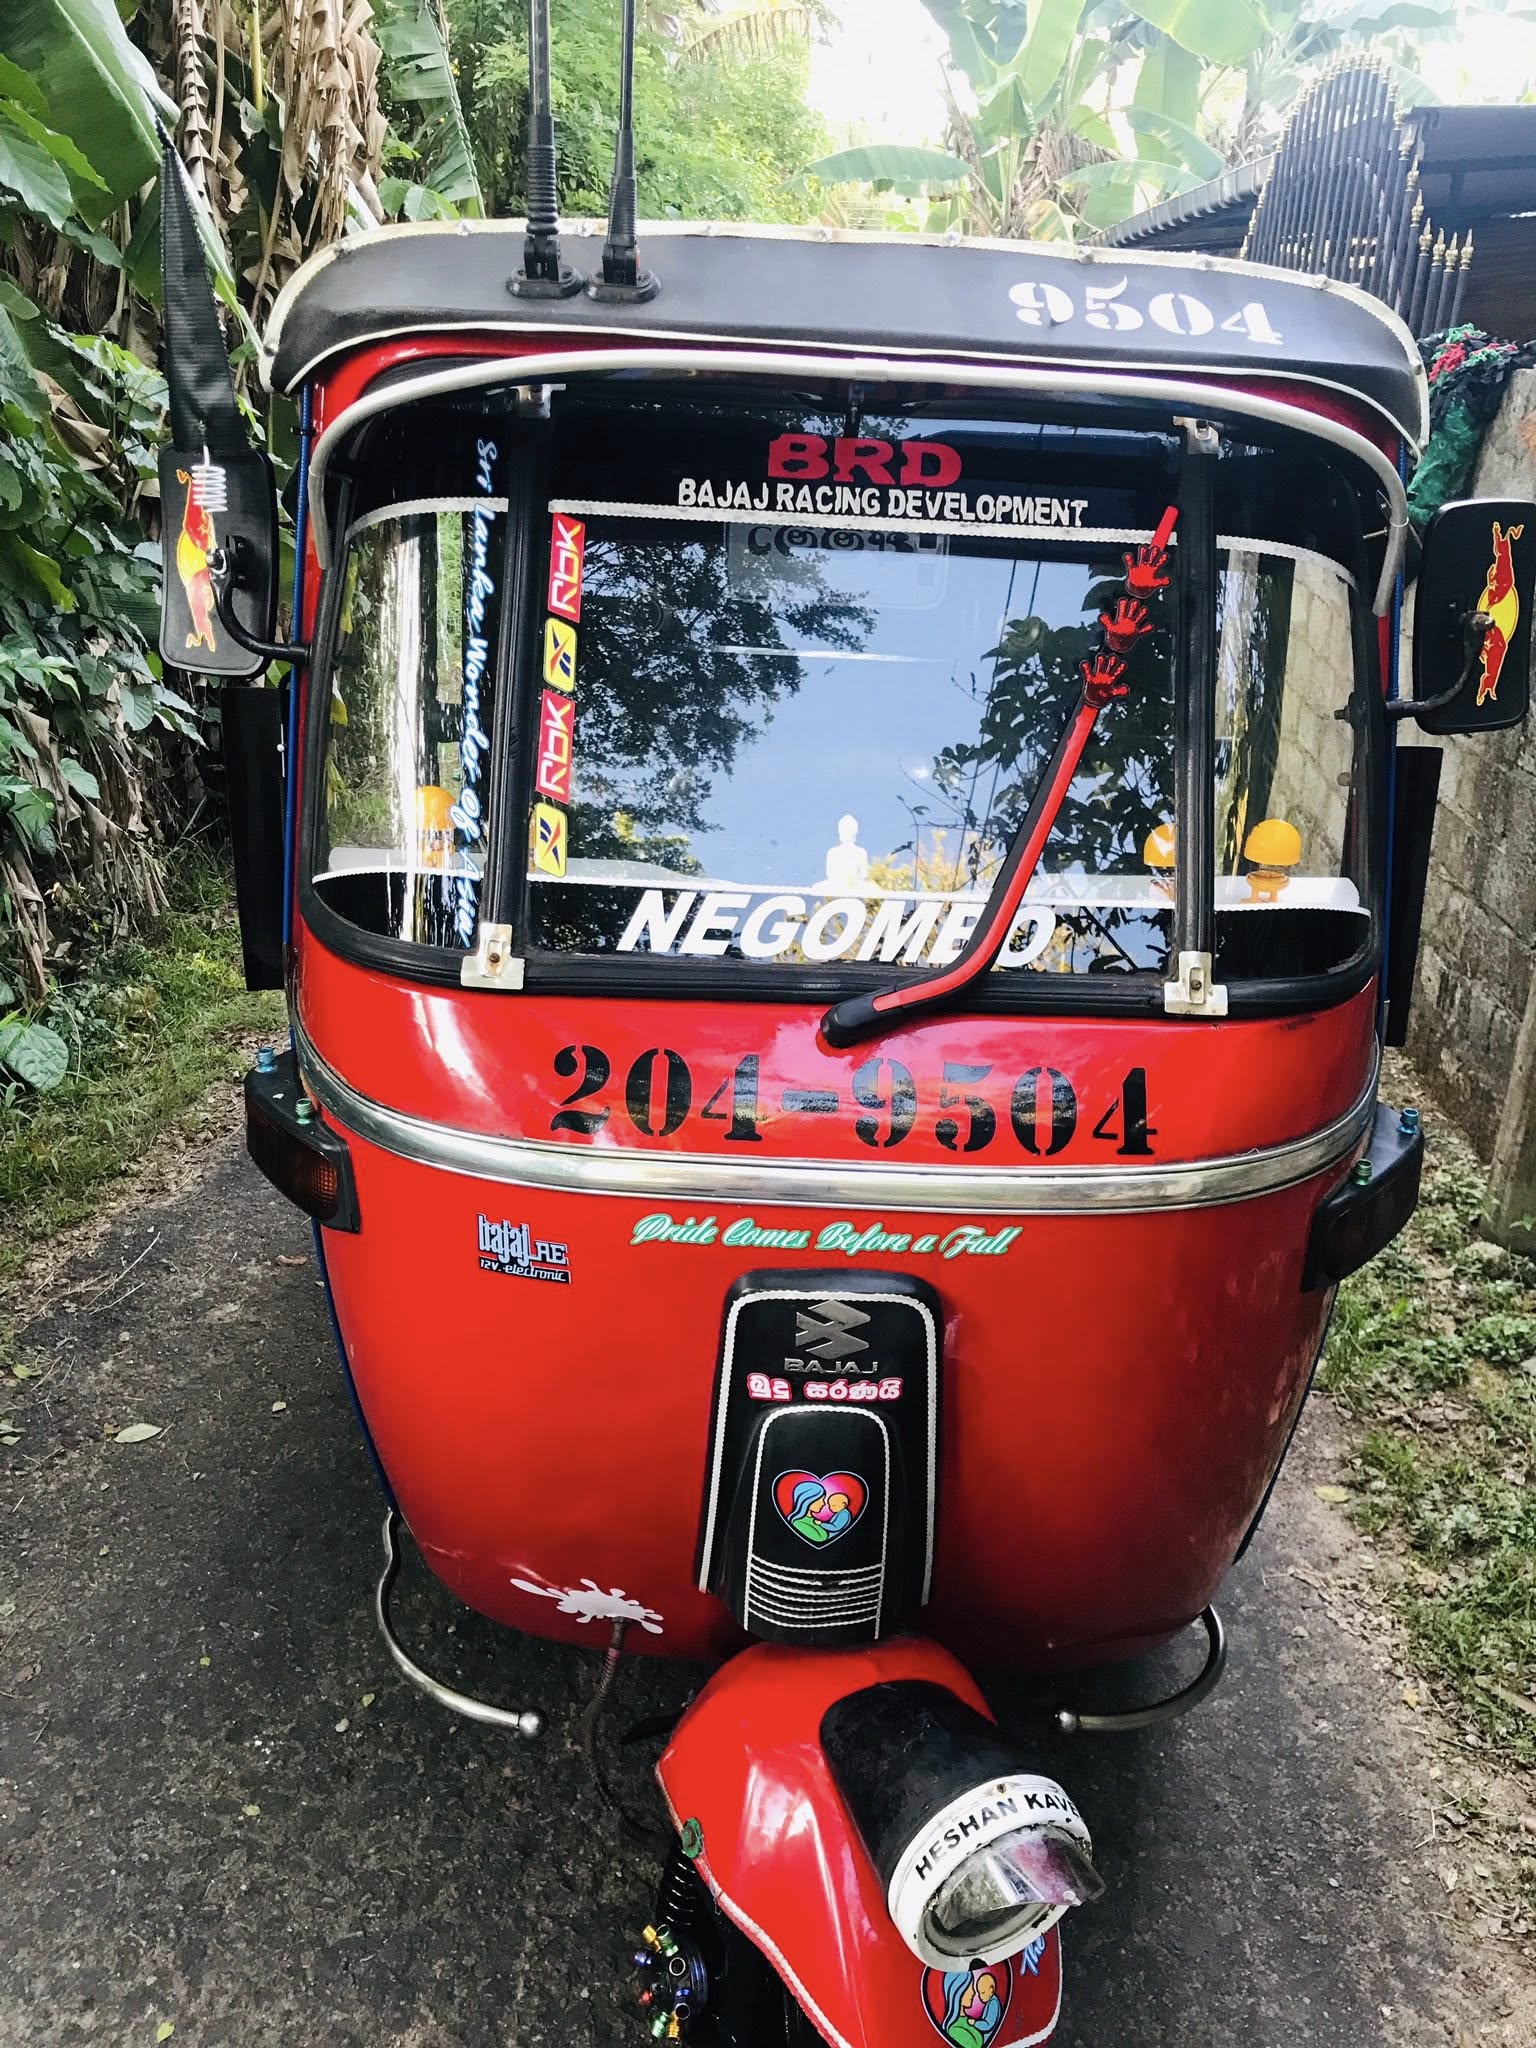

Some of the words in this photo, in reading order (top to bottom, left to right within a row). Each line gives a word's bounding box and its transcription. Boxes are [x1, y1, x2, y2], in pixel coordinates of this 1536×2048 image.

[1008, 274, 1284, 346] 9504
[476, 438, 498, 494] Sri
[767, 433, 962, 487] BRD
[678, 478, 769, 512] BAJAJ
[776, 483, 881, 516] RACING
[887, 488, 1089, 527] DEVELOPMENT
[469, 503, 496, 635] Lanka
[461, 638, 490, 783] Wonder
[455, 846, 481, 949] Asia
[616, 889, 1056, 968] NEGOMBO
[549, 1043, 1159, 1157] 204-9504
[629, 1213, 720, 1246] Pride
[721, 1218, 811, 1250] Comes
[814, 1221, 913, 1256] Before
[910, 1233, 940, 1254] a
[939, 1224, 1024, 1259] Fall
[784, 1358, 879, 1375] BAJAJ
[914, 1797, 1019, 1882] HESHAN
